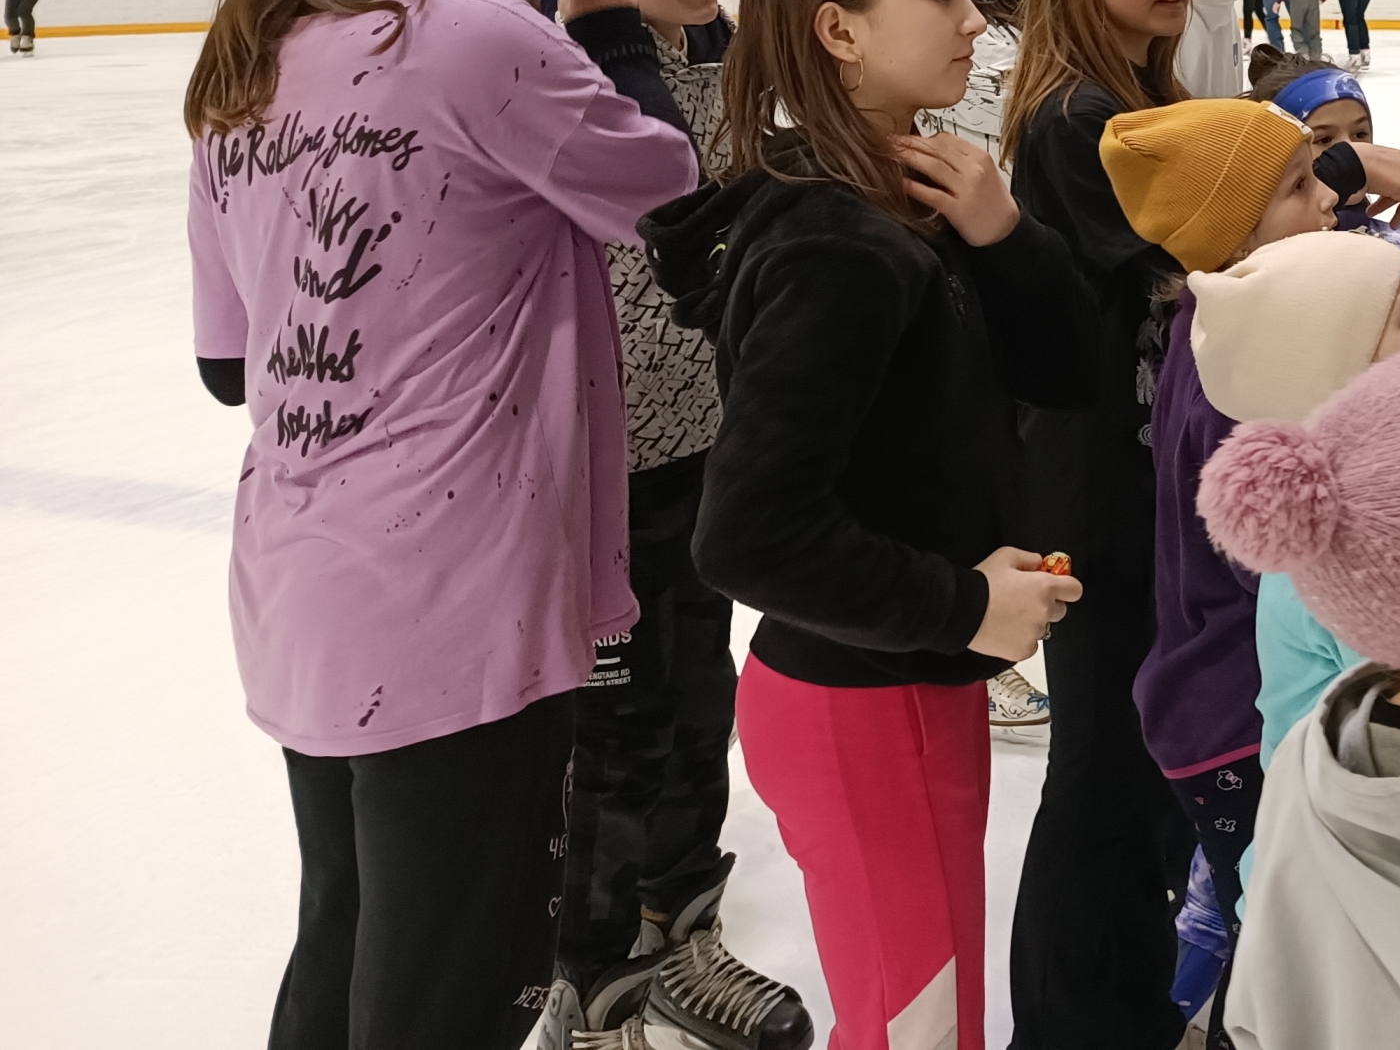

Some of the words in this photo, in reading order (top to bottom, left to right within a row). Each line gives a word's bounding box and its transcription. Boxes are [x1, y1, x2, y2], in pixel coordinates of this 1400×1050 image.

[247, 110, 328, 192] Rolling
[322, 111, 424, 171] Stones
[606, 676, 631, 686] STREET
